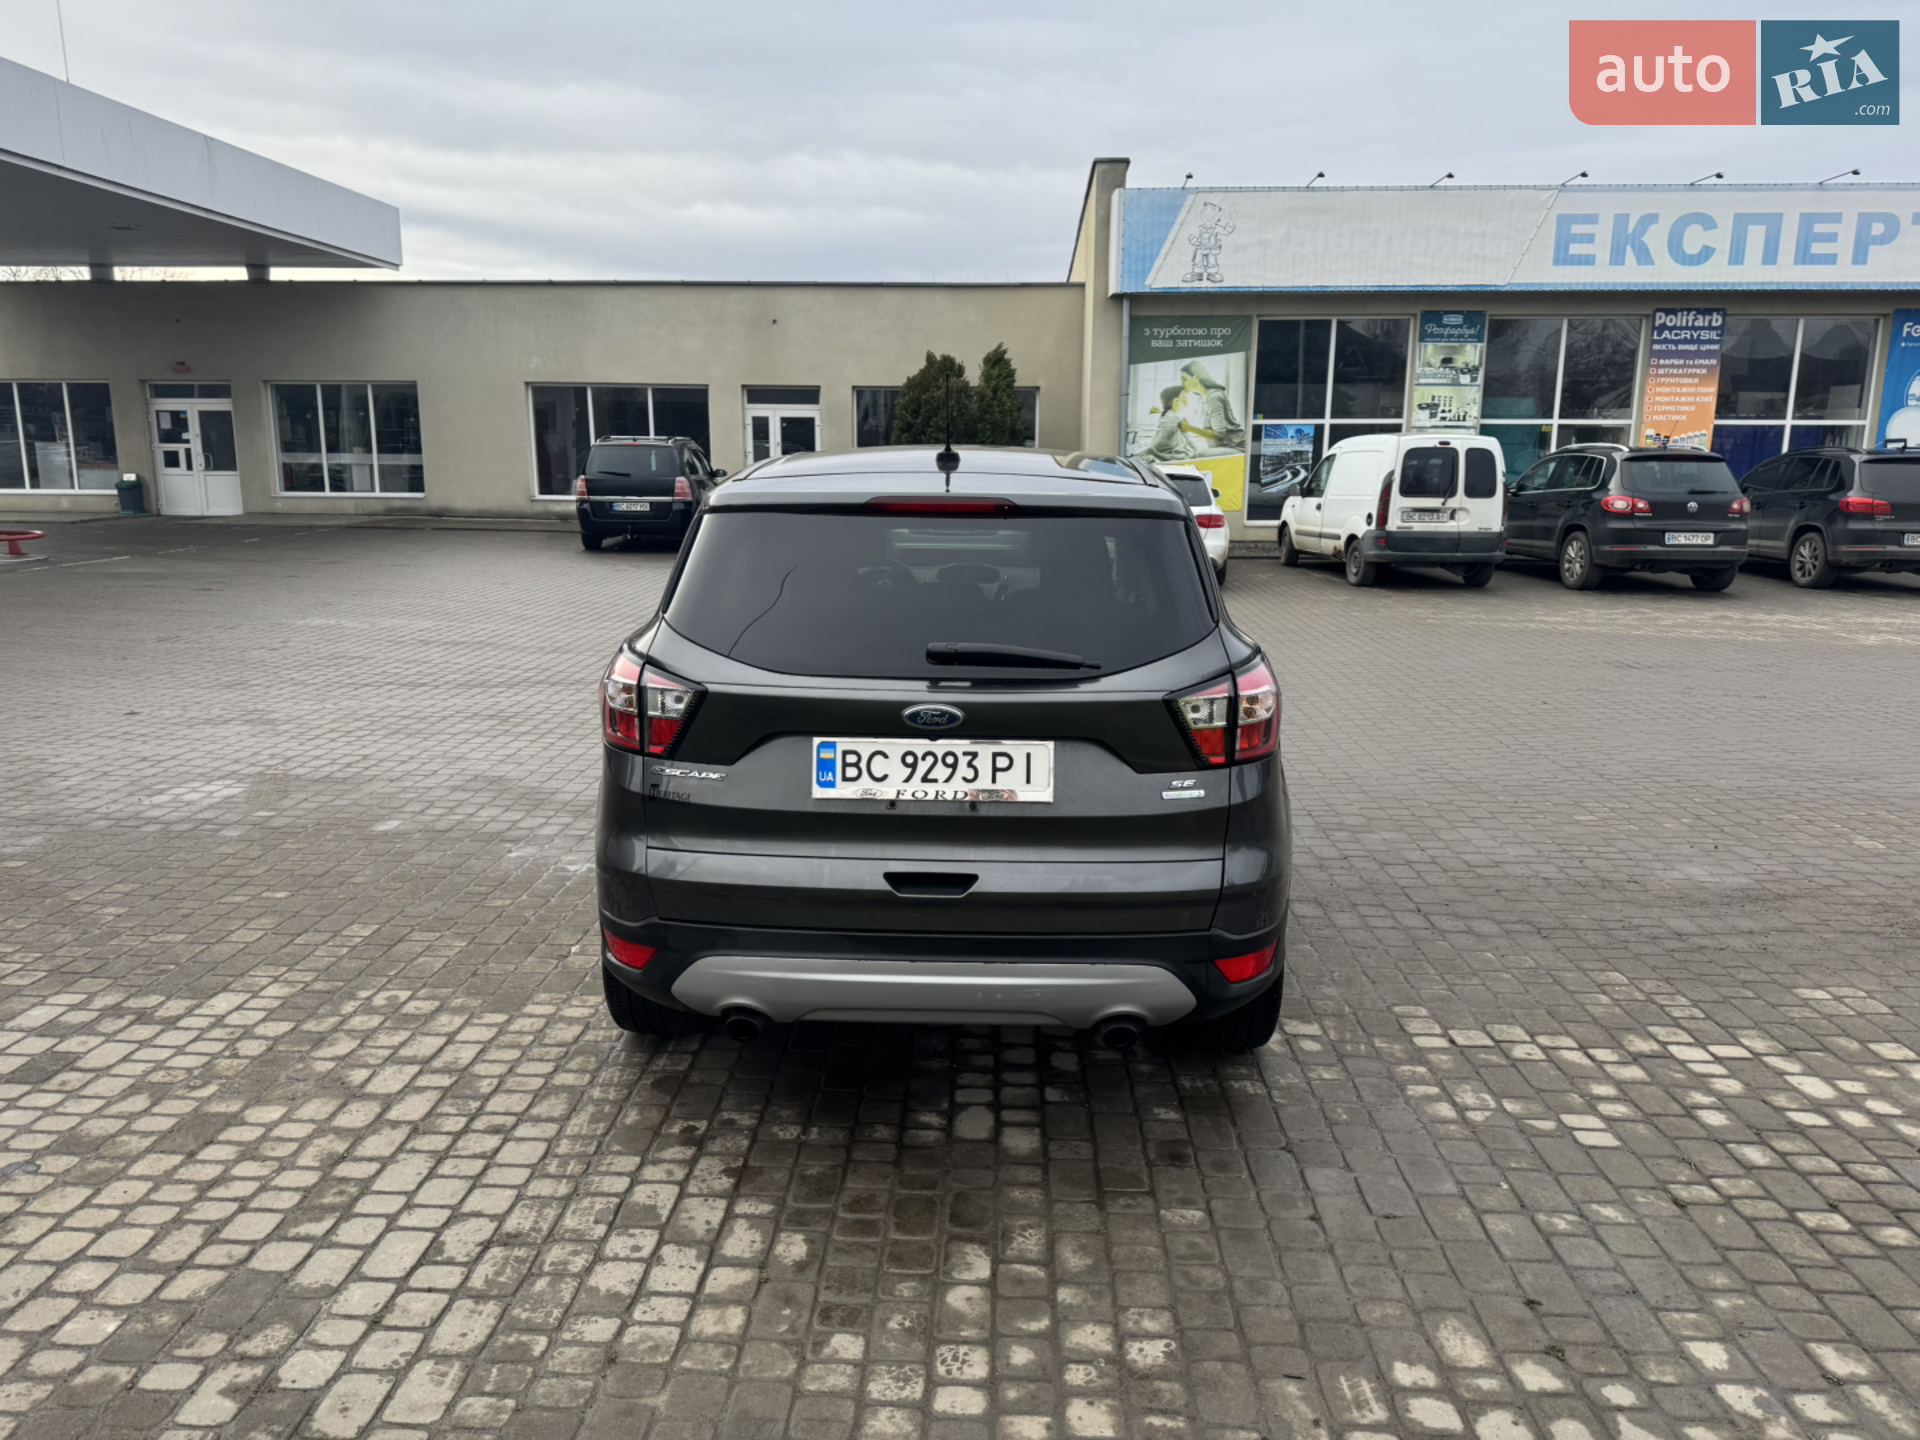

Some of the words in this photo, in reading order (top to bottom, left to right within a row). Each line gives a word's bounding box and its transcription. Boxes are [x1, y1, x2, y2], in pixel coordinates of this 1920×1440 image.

[1654, 311, 1724, 328] Polifarb
[1143, 327, 1151, 336] з
[1152, 324, 1208, 338] турботою
[1210, 327, 1232, 338] про
[1653, 330, 1721, 340] LACRYSIL
[1151, 339, 1173, 348] ваш
[1175, 339, 1224, 348] затишок
[1671, 533, 1682, 543] BC
[916, 709, 949, 725] Ford
[841, 749, 889, 783] BC
[900, 750, 979, 783] 9293
[649, 765, 728, 781] ESCAPE
[819, 771, 834, 782] UA
[1168, 779, 1197, 789] SE
[895, 789, 968, 800] FORD
